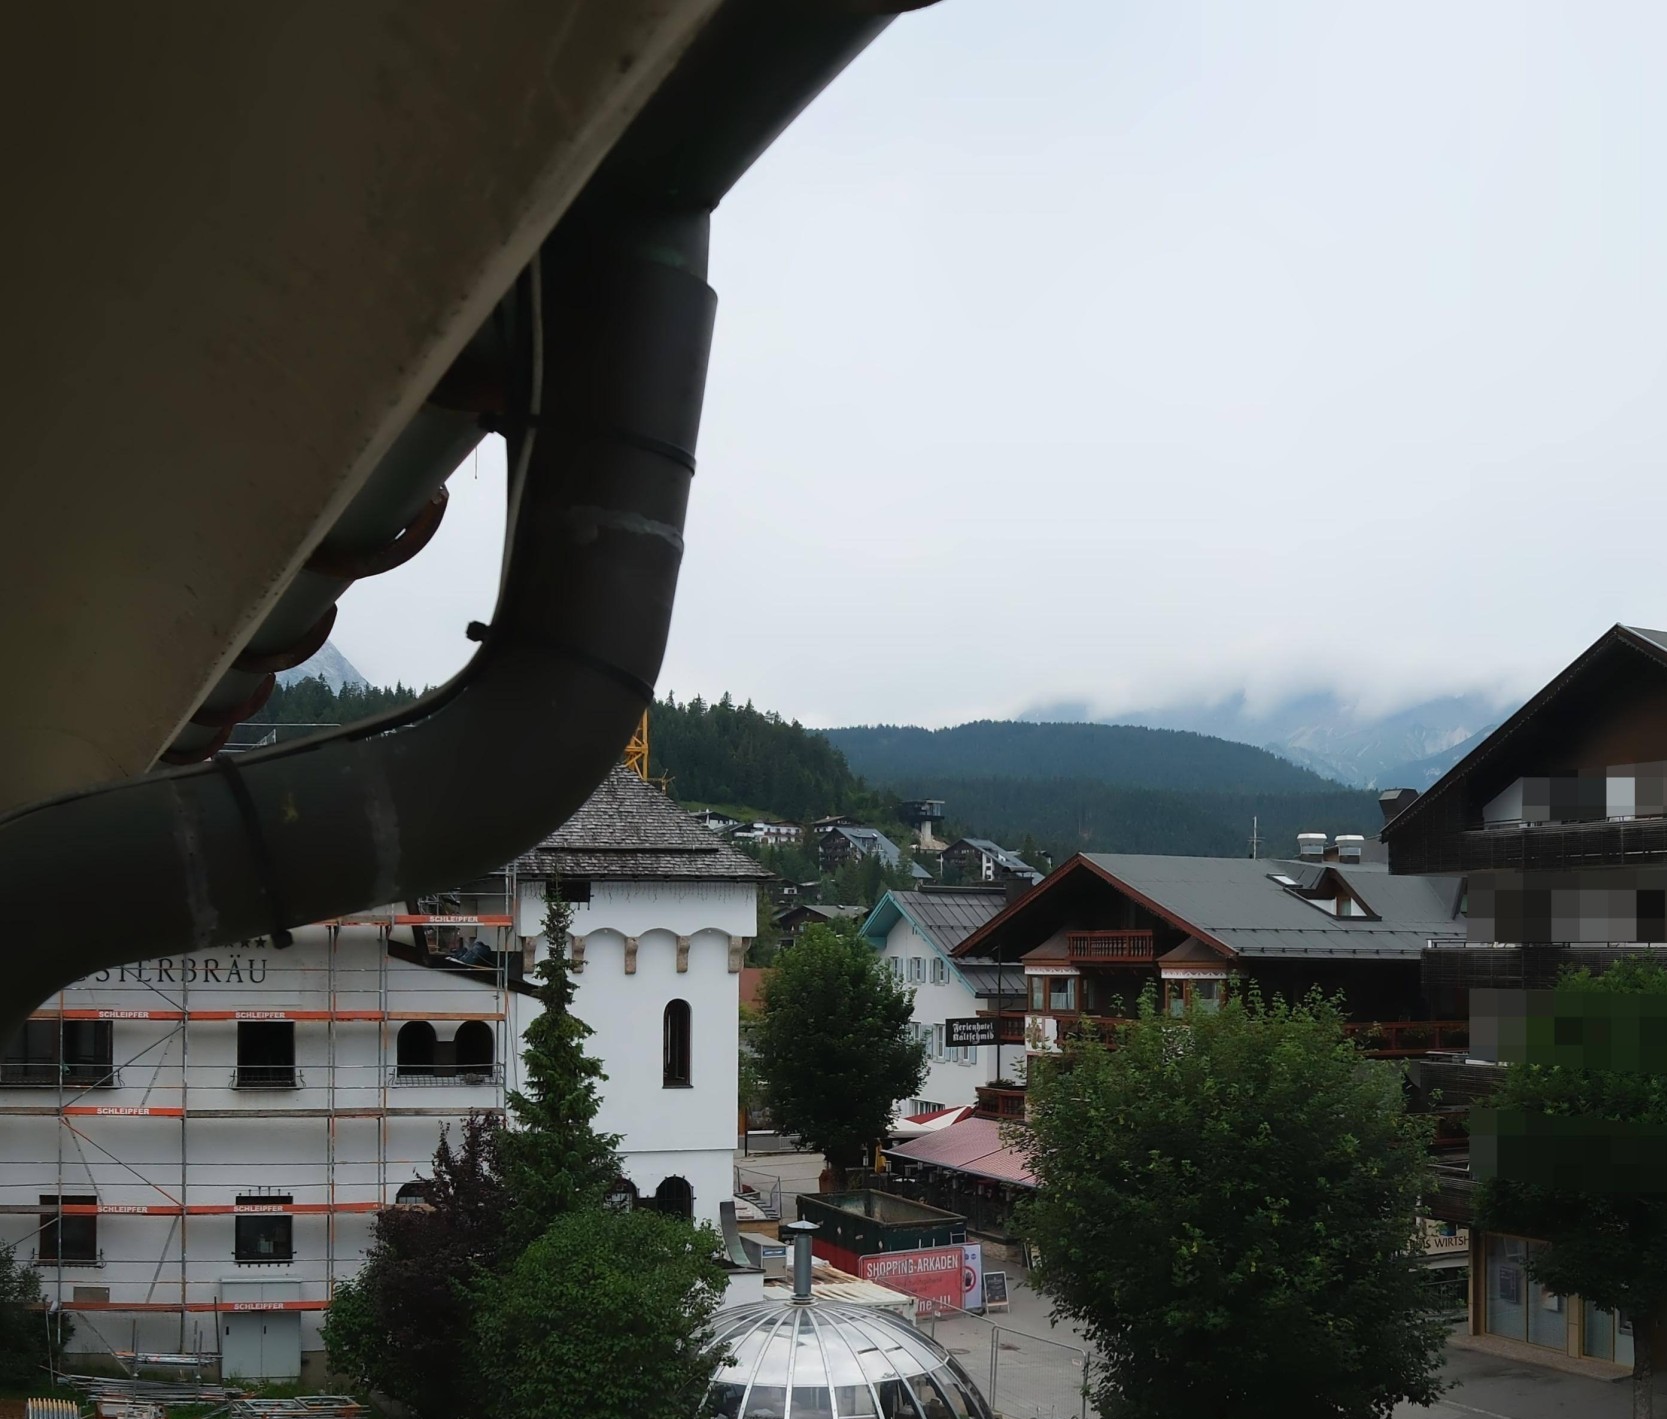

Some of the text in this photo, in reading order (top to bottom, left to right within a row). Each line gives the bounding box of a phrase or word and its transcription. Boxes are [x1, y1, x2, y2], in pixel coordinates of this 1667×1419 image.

[98, 1010, 149, 1018] SCHLEIPFER
[235, 1011, 285, 1019] SCHLEIPFER
[97, 1107, 149, 1115] SCHLEIPFER
[866, 1254, 958, 1278] SHOPPING-ARKADEN
[234, 1302, 284, 1310] SCHLEIPFER
